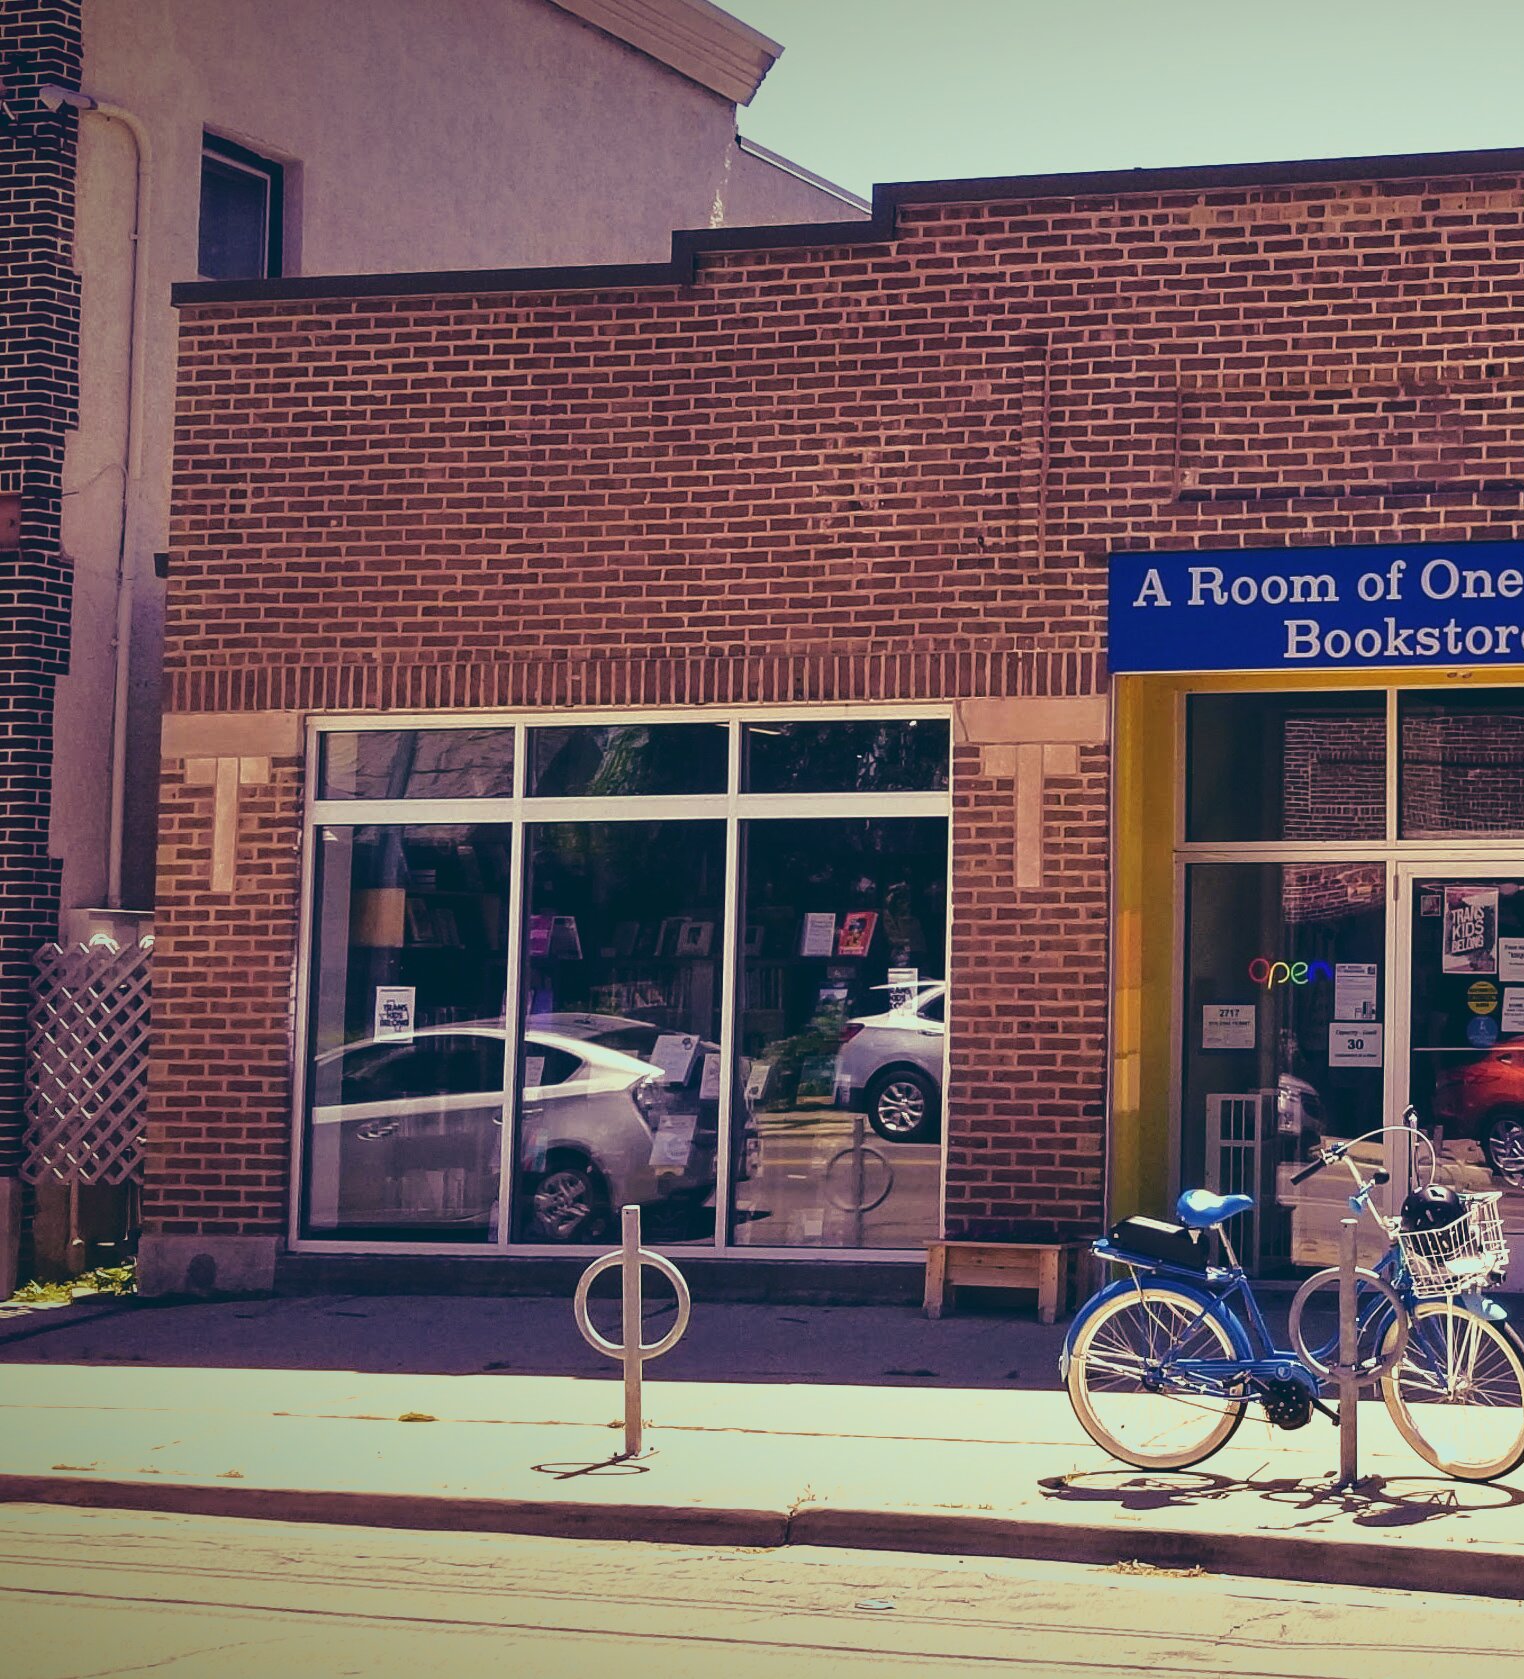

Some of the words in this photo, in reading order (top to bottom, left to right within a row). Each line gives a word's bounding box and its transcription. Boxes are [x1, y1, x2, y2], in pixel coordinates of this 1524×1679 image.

[1133, 568, 1171, 607] A
[1187, 566, 1340, 606] Room
[1357, 560, 1407, 602] of
[1452, 904, 1485, 924] TRANS
[1453, 920, 1484, 940] KIDS
[1452, 936, 1484, 954] BELONG
[1219, 1009, 1240, 1017] 2717
[1347, 1039, 1364, 1050] 30
